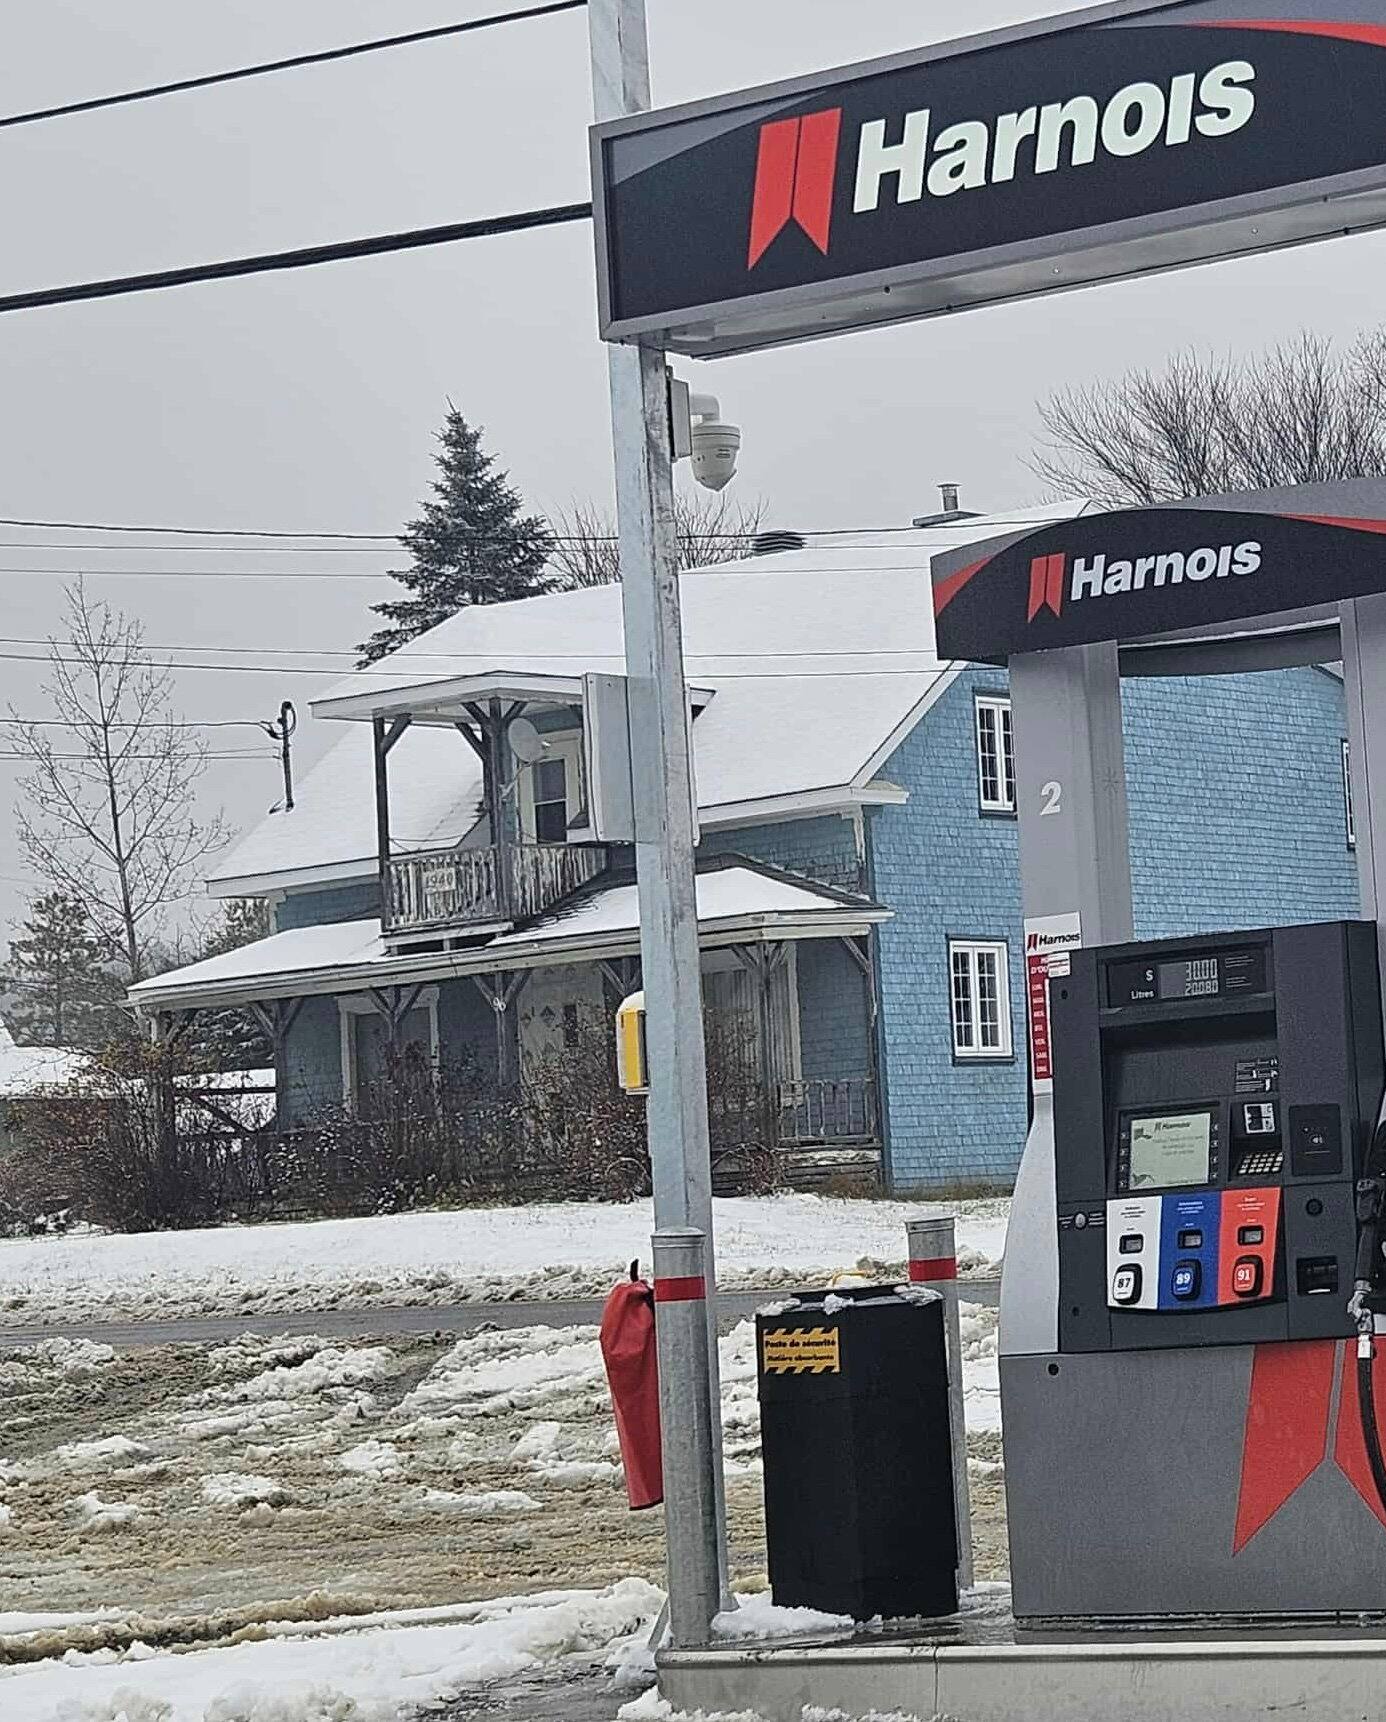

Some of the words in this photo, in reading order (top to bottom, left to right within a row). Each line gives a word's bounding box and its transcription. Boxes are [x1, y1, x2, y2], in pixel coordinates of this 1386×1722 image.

[853, 60, 1256, 214] Harnois
[1070, 541, 1262, 601] Harnois
[1040, 781, 1061, 816] 2
[1039, 932, 1081, 946] Harnois
[1130, 990, 1155, 1000] Litres
[1176, 1272, 1191, 1285] 89
[1237, 1268, 1250, 1281] 91
[1117, 1277, 1131, 1289] 87
